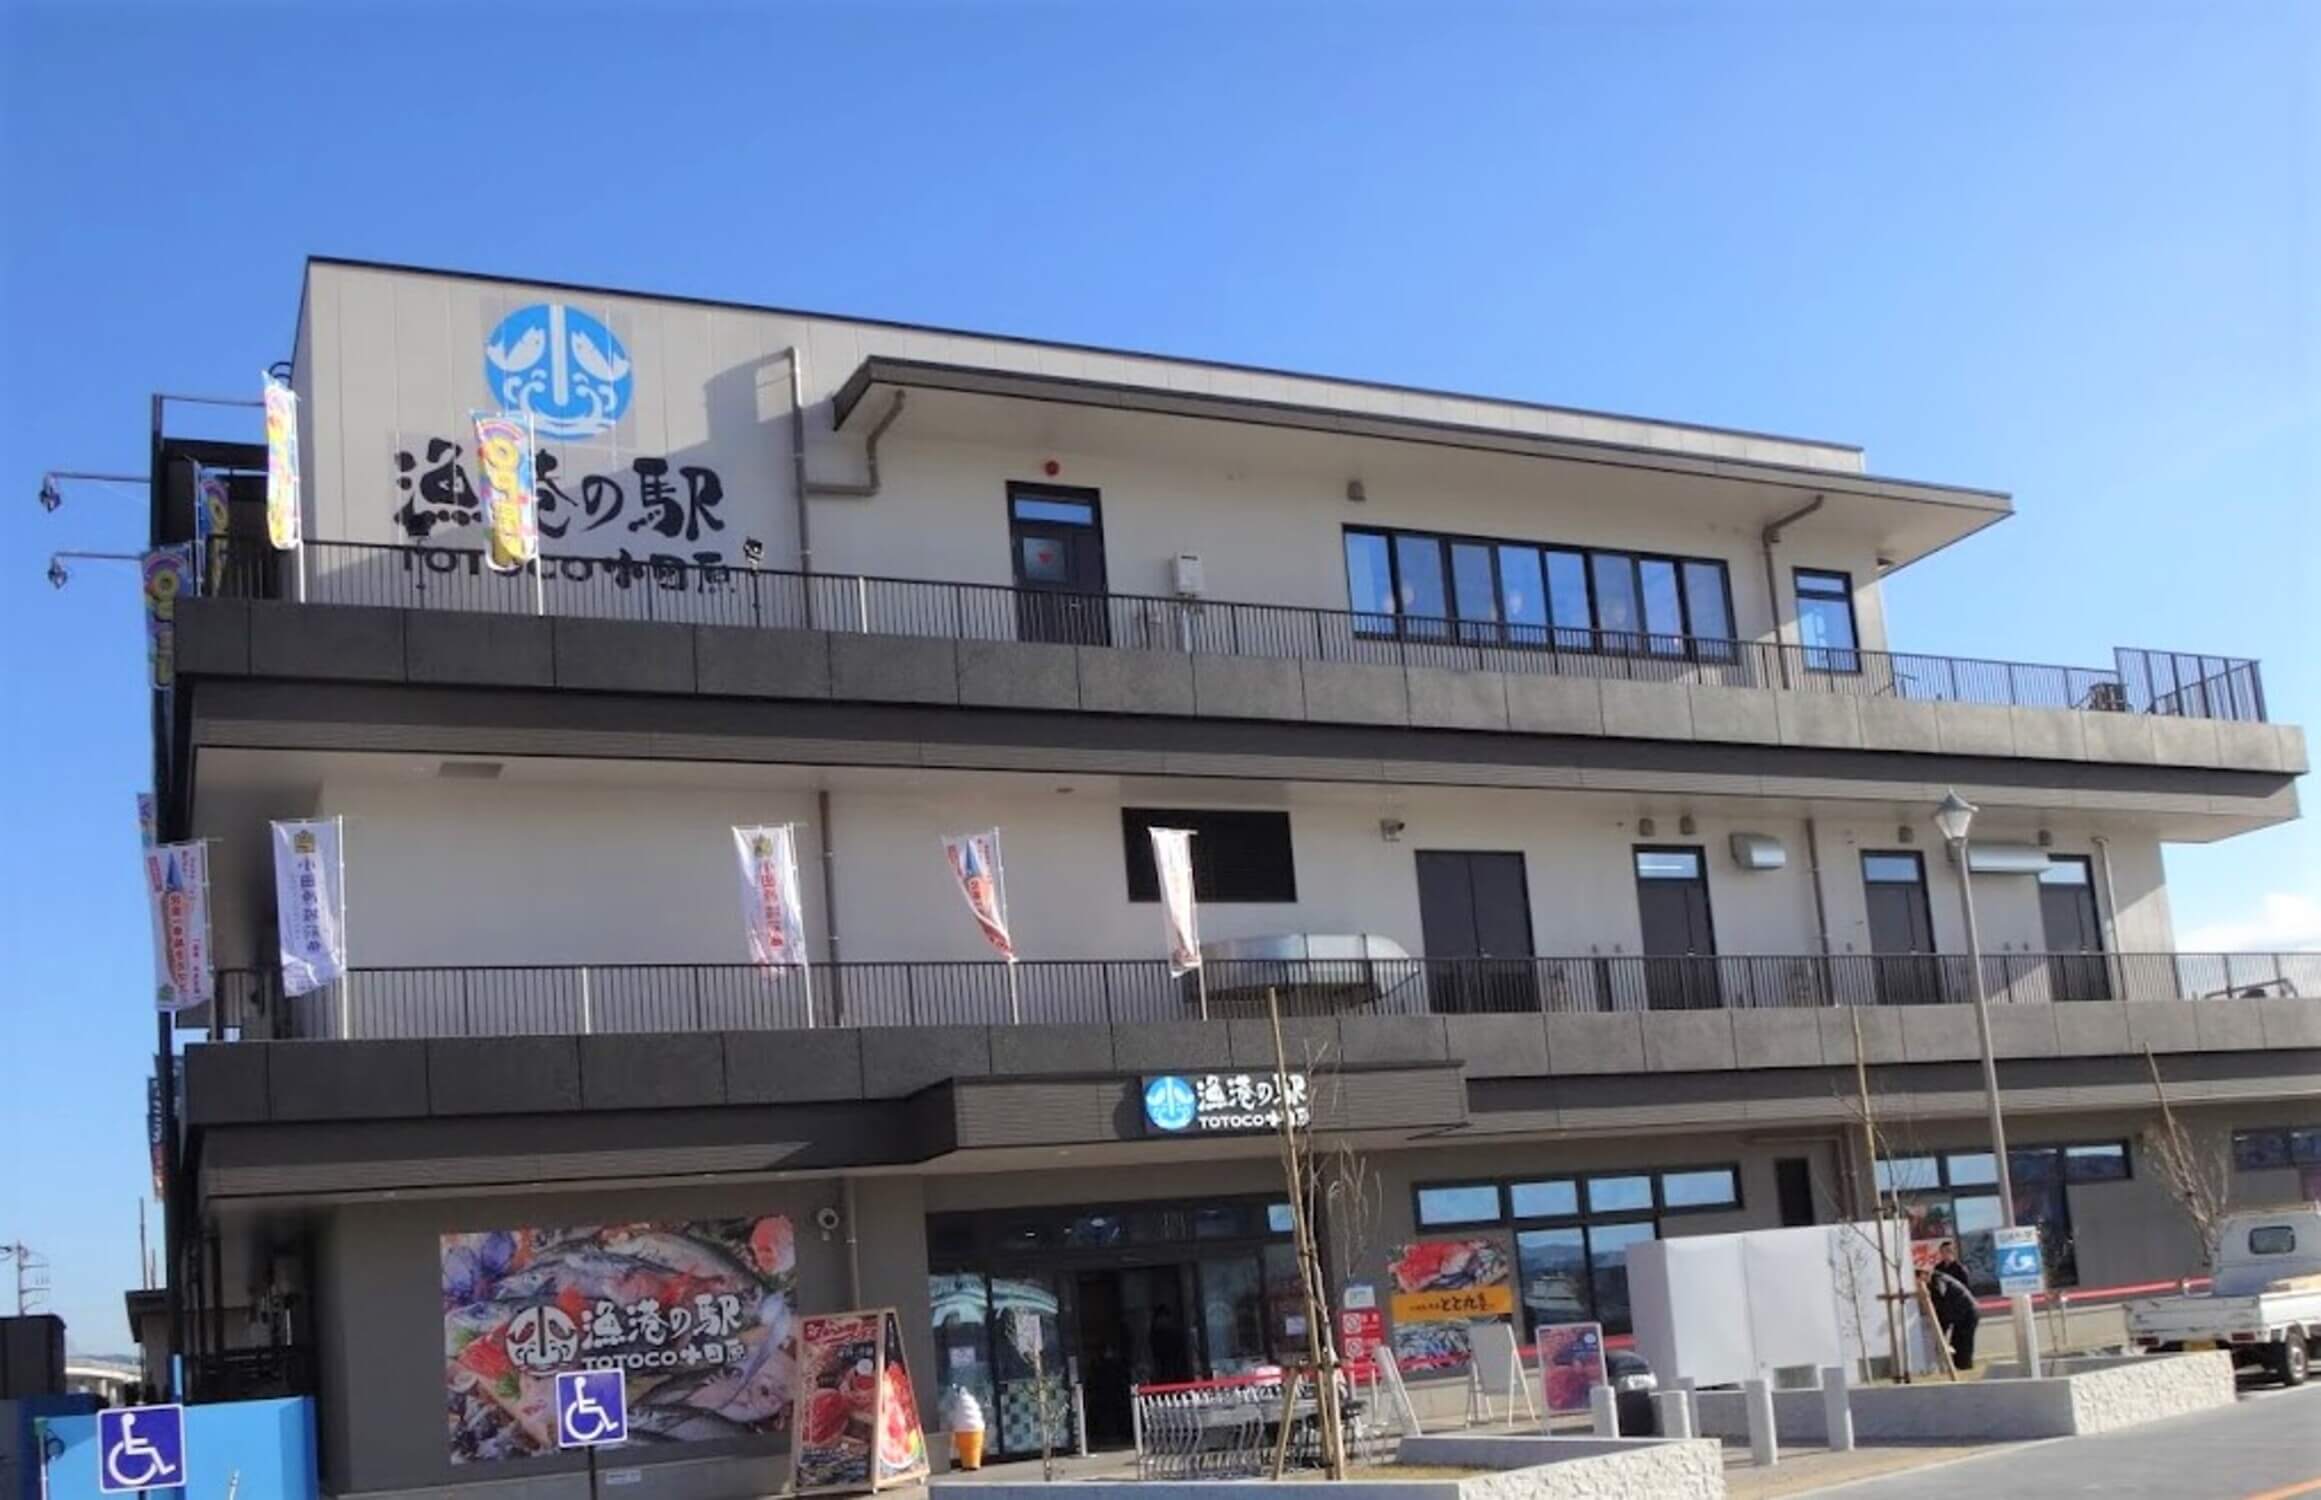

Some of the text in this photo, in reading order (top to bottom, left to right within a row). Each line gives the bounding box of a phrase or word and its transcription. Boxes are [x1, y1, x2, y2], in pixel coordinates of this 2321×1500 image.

[1196, 1073, 1307, 1111] 漁港の駅
[581, 1294, 741, 1350] 漁港の駅
